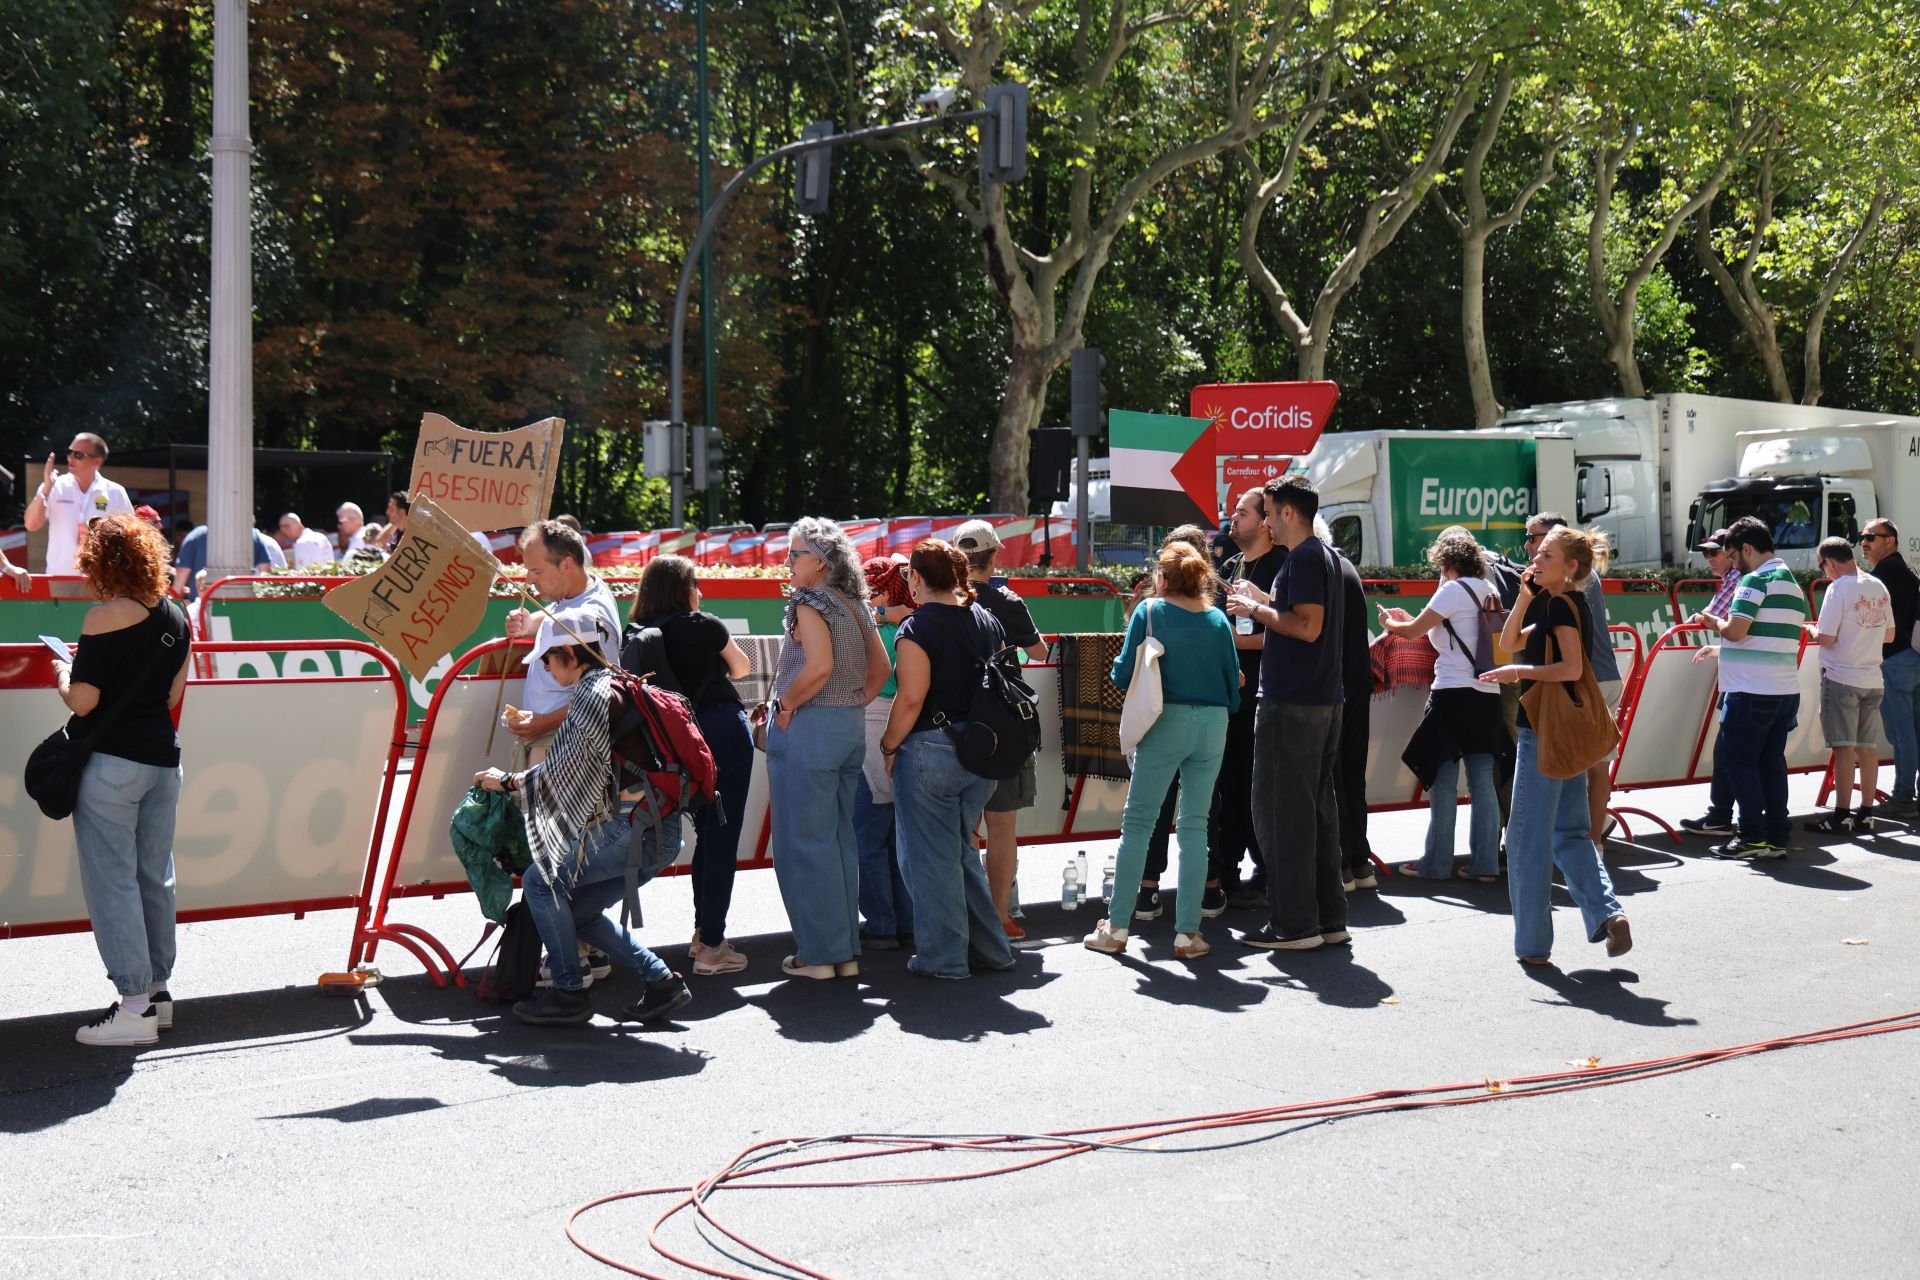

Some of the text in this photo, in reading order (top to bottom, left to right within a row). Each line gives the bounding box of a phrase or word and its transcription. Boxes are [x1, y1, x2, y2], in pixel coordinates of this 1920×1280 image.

[1231, 406, 1313, 429] Cofidis
[451, 439, 548, 478] FUERA!
[1227, 467, 1260, 476] Carrefour
[415, 472, 530, 506] ASESINOS
[371, 535, 439, 612] FUERA
[400, 555, 476, 660] ASESINOS
